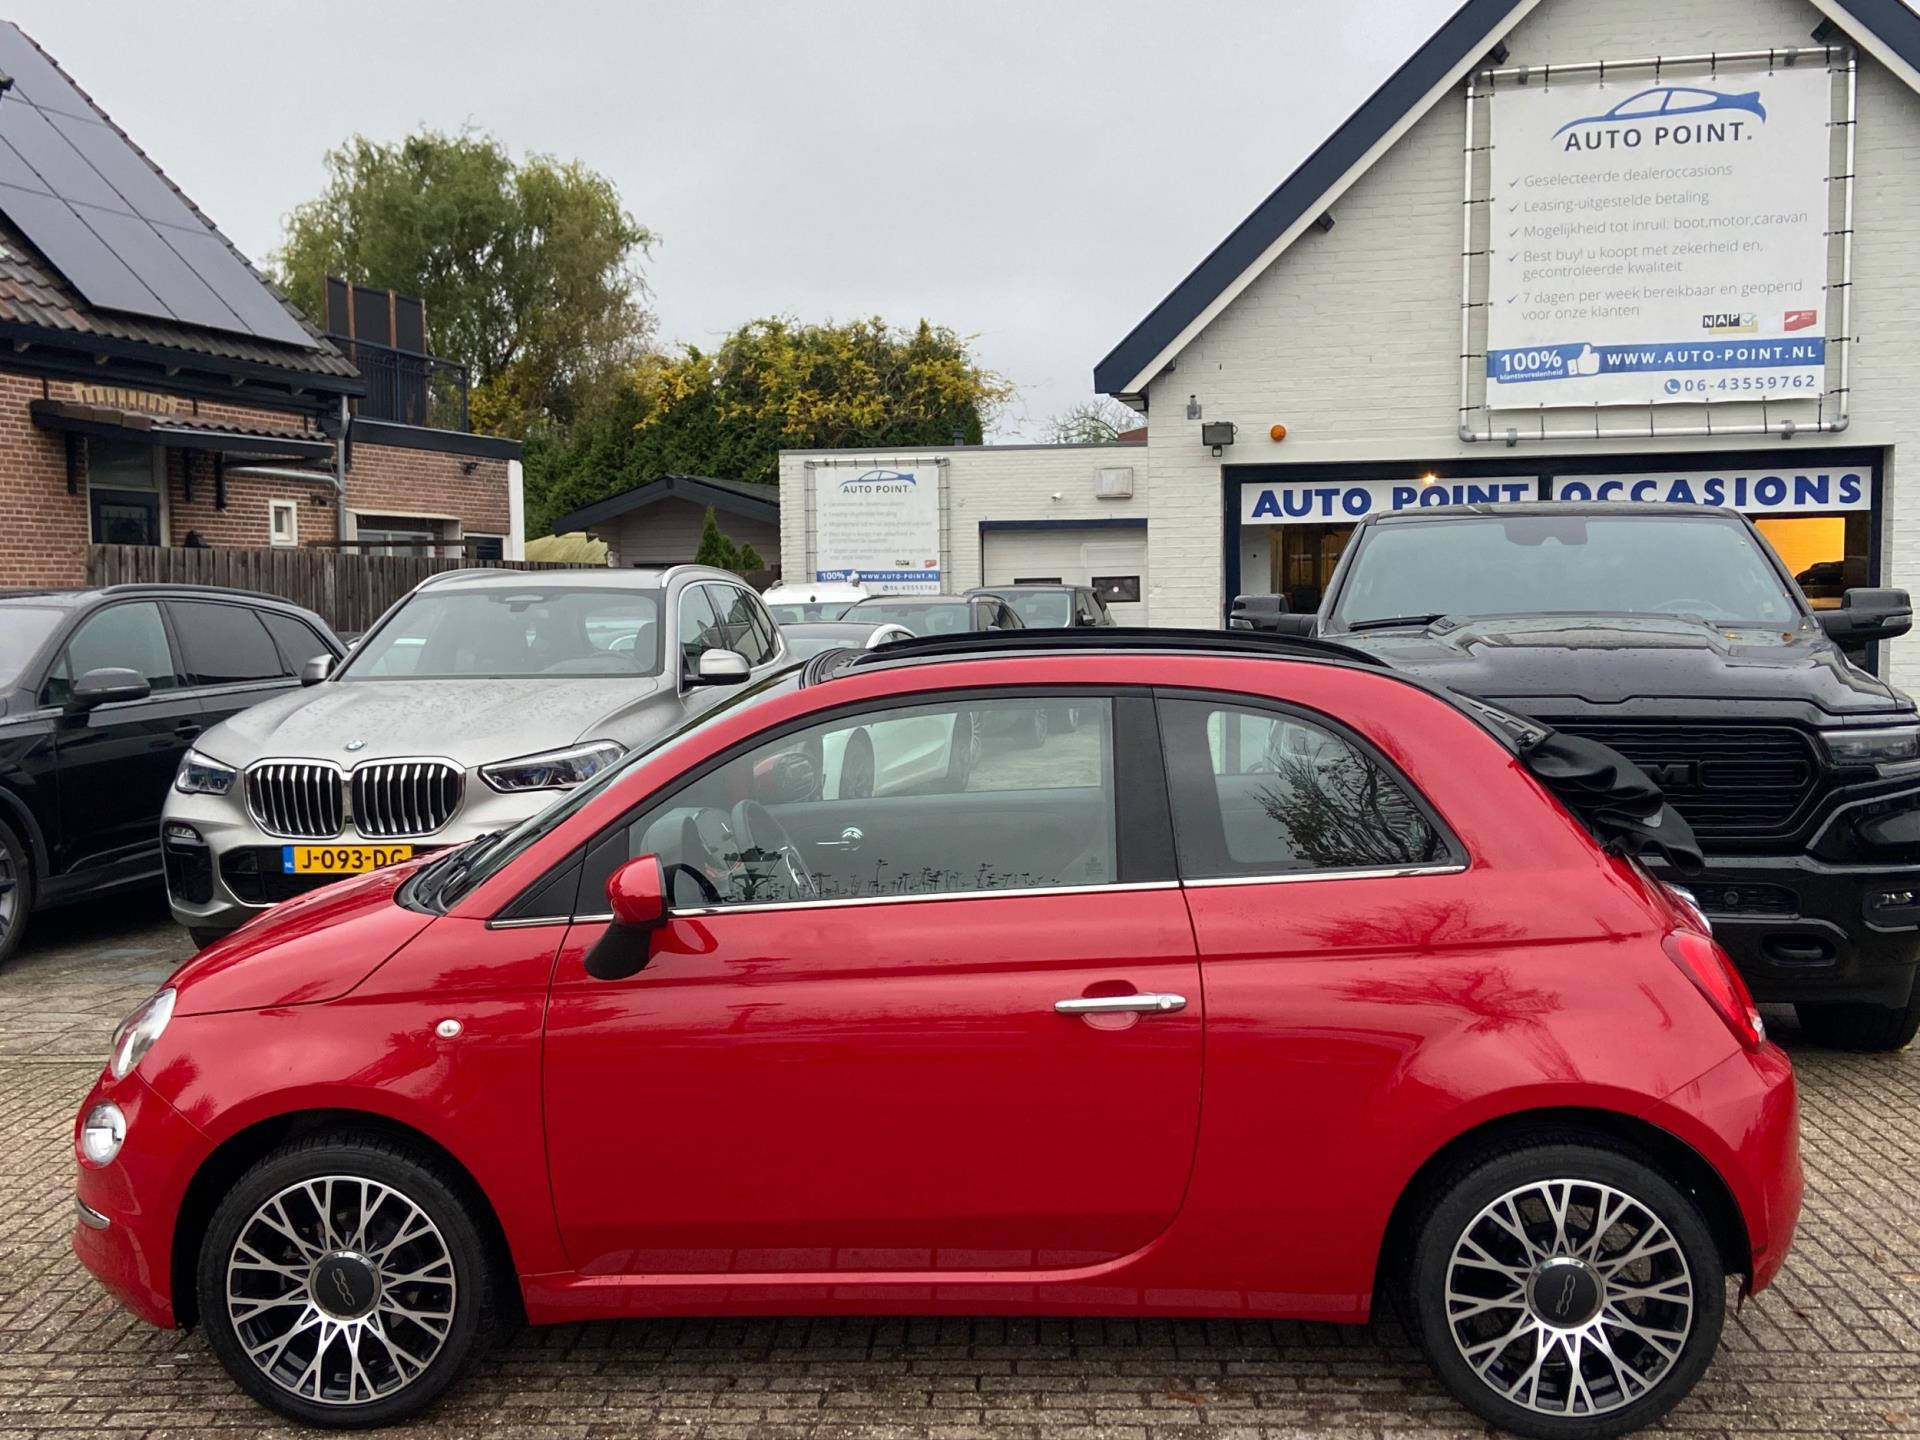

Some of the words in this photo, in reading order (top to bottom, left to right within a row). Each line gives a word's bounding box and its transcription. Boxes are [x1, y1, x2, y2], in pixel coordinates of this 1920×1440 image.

[1564, 128, 1642, 152] AUTO
[1524, 170, 1620, 188] Geselecteerde
[1623, 164, 1733, 182] dealeroccasions
[1524, 193, 1651, 214] Leasing-uitgestelde
[1655, 191, 1710, 206] betaling
[1524, 222, 1606, 240] Mogelijkheid
[1610, 221, 1628, 233] tot
[1523, 250, 1551, 263] Best
[1556, 248, 1583, 264] buy!
[1587, 250, 1596, 260] u
[1600, 246, 1638, 260] koopt
[1642, 244, 1668, 257] met
[1672, 240, 1738, 256] zekerheid
[1522, 263, 1624, 282] gecontroleerde
[1628, 261, 1682, 274] kwaliteit
[1522, 292, 1531, 304] 7
[1534, 291, 1575, 306] dagen
[1579, 290, 1601, 304] per
[1605, 287, 1640, 300] week
[1643, 284, 1716, 299] bereikbaar
[1720, 284, 1737, 295] en
[1741, 280, 1803, 297] geopend
[1522, 309, 1551, 321] voor
[1555, 308, 1587, 319] onze
[1591, 305, 1640, 318] klanten
[1703, 313, 1740, 328] NAP
[1500, 350, 1562, 372] 100%
[1607, 345, 1816, 365] WWW.AUTO-POINT.NL
[1685, 375, 1815, 392] 06-43559762
[843, 485, 872, 493] AUTO
[1560, 474, 1862, 506] OCCASIONS
[1252, 487, 1372, 518] AUTO
[1393, 484, 1528, 510] POINT
[822, 571, 845, 580] 100%
